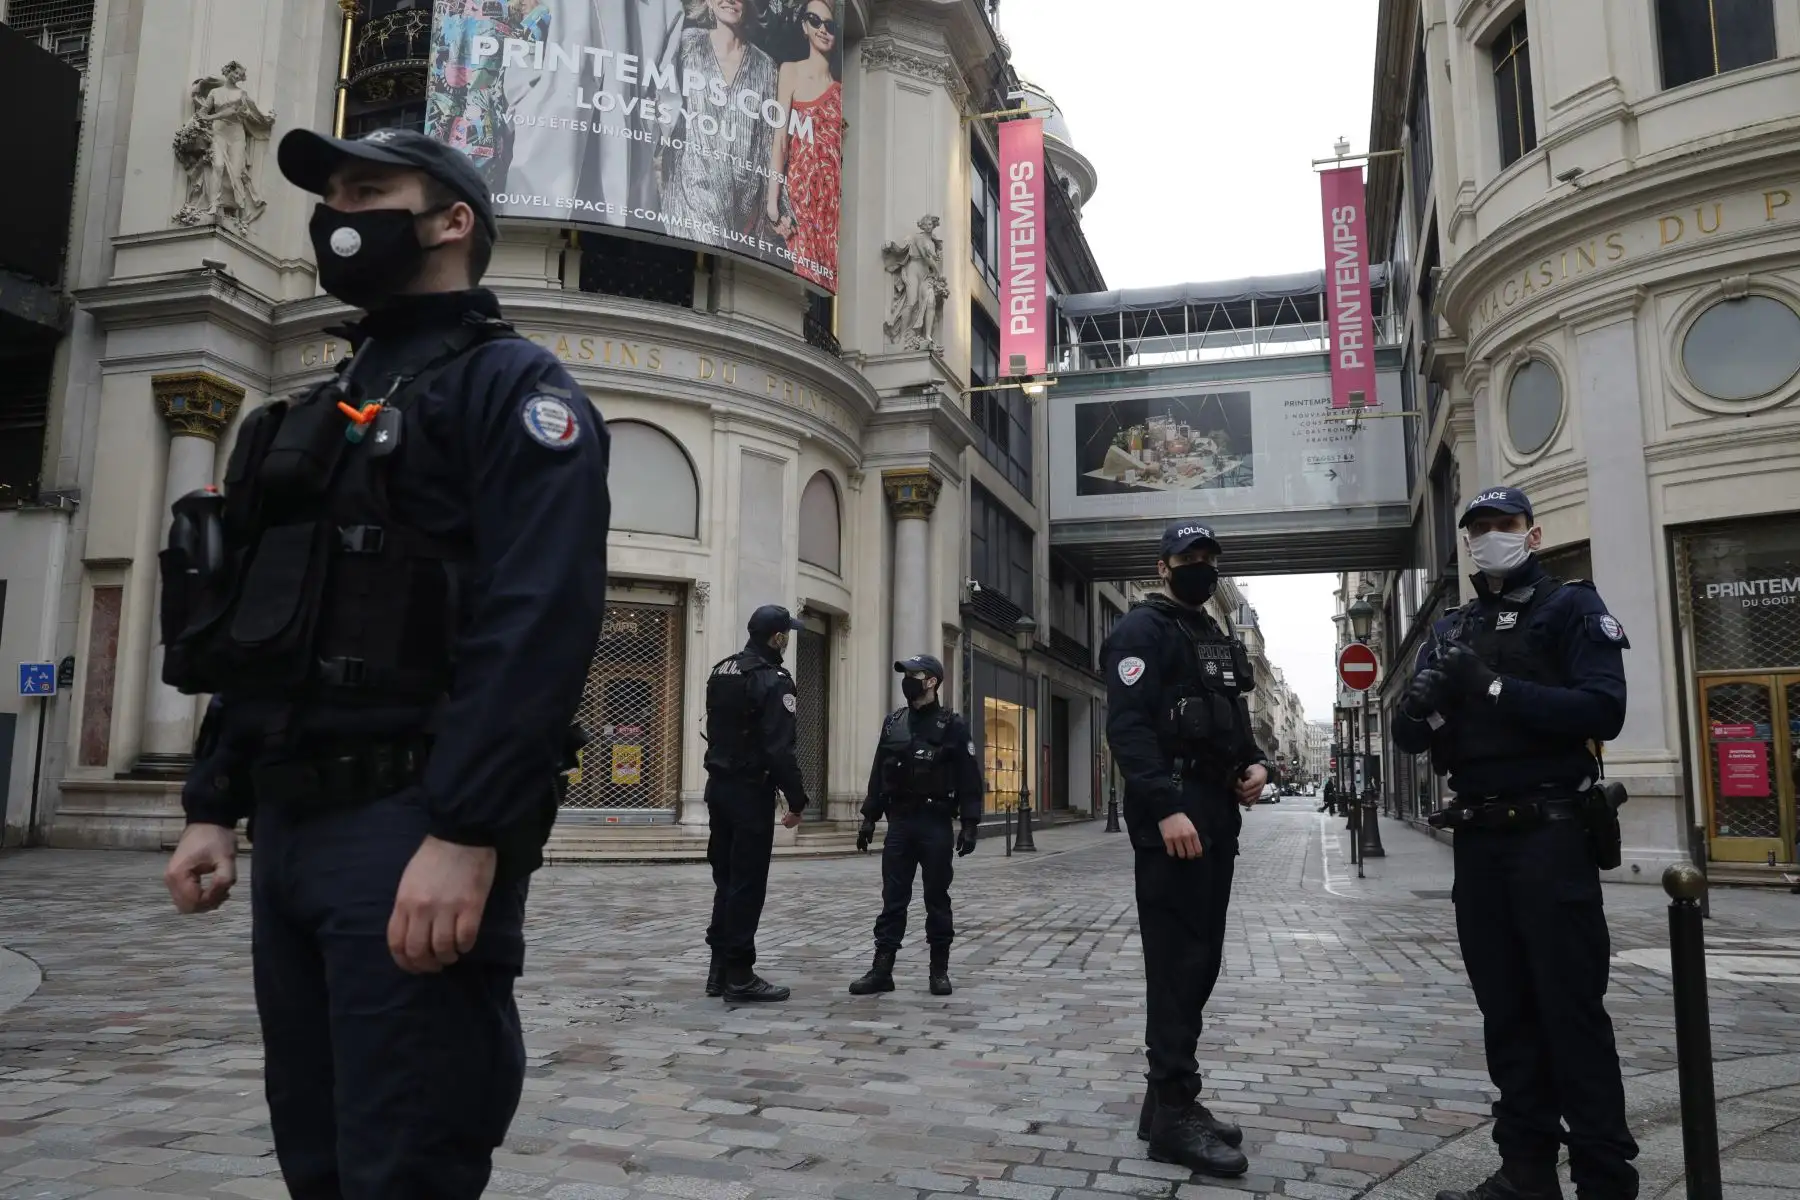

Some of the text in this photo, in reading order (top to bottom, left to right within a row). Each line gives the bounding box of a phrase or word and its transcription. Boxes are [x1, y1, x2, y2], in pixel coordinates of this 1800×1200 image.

[471, 35, 814, 145] PRINTEMPS.COM
[576, 87, 737, 142] LOVES YOU
[502, 113, 545, 128] VOUS
[660, 137, 711, 157] NOTRE
[713, 151, 753, 172] STYLE
[555, 197, 614, 214] ESPACE
[620, 206, 720, 236] E-COMMERCE
[724, 230, 756, 247] LUXE
[759, 240, 774, 254] ET
[1010, 161, 1035, 335] PRINTEMPS
[1332, 205, 1365, 370] PRINTEMPS
[1479, 232, 1626, 326] MAGASINS
[1658, 203, 1722, 247] DU
[700, 357, 737, 385] DU
[1284, 398, 1331, 407] PRINTEMPS
[1470, 491, 1507, 508] POLICE
[1178, 526, 1211, 538] POLICE
[1742, 599, 1758, 608] DU
